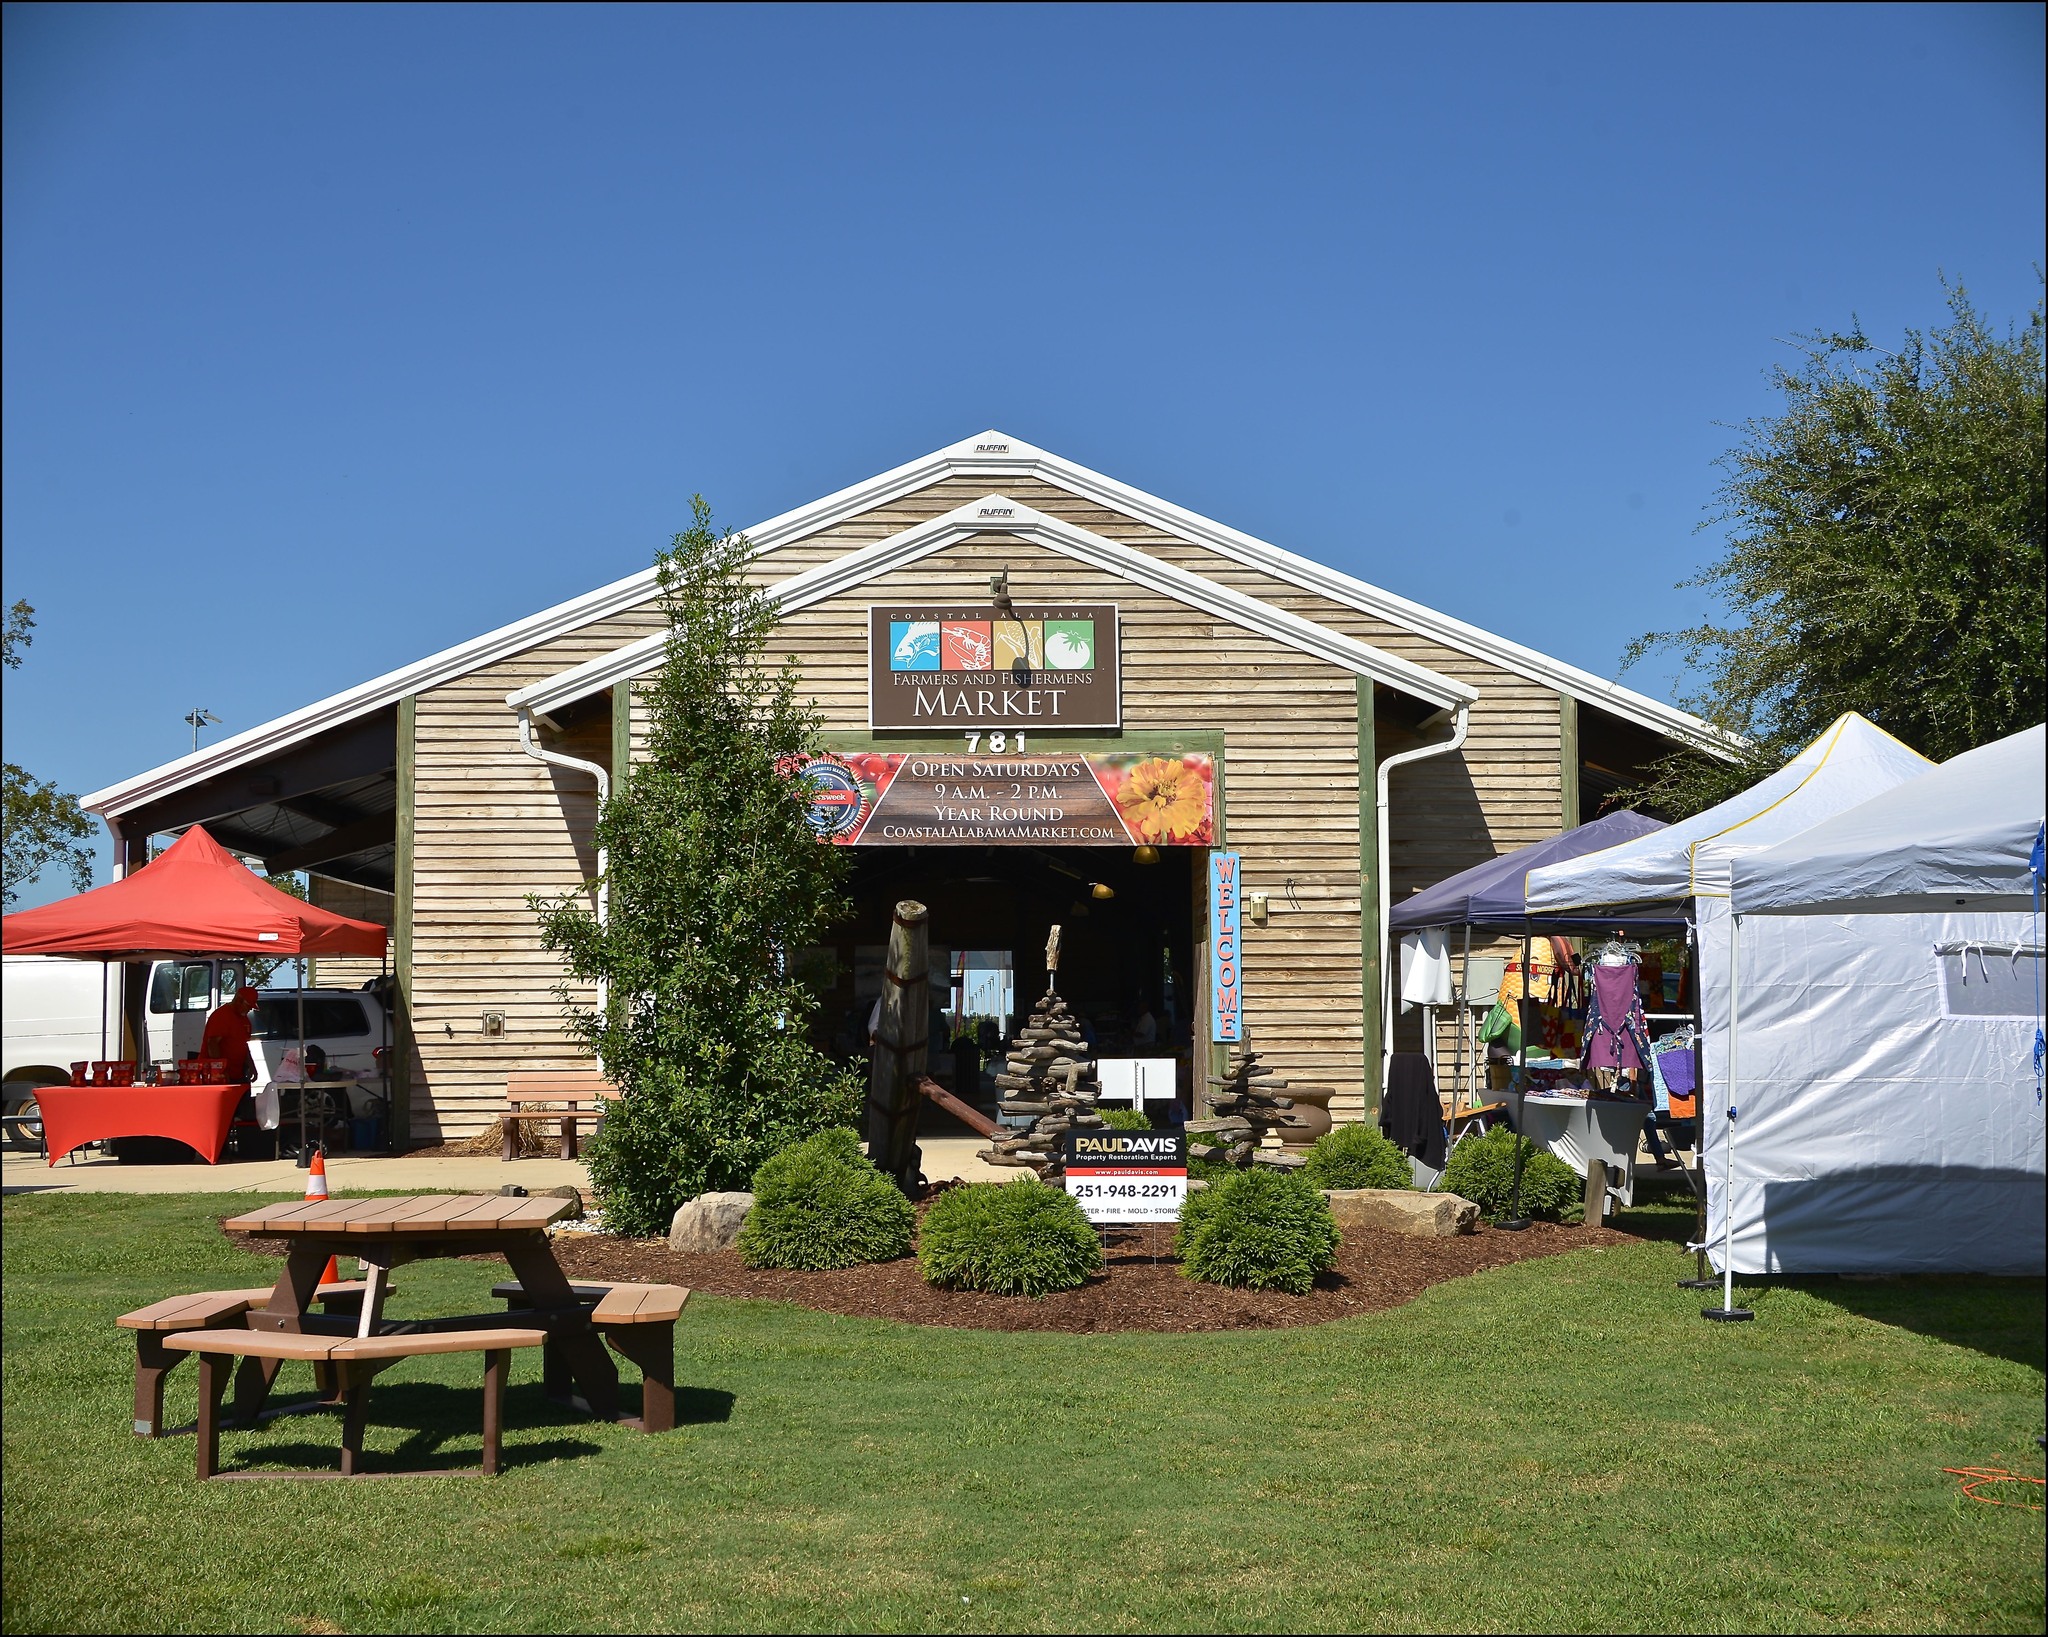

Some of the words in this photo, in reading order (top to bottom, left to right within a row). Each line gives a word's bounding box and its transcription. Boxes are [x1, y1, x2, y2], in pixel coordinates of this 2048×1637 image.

[890, 612, 982, 620] COASTAL
[893, 673, 958, 686] FARMERS
[963, 674, 996, 685] AND
[1001, 673, 1093, 685] FISHERMENS
[912, 687, 1066, 717] MARKET
[964, 731, 1026, 753] 781
[911, 761, 965, 777] OPEN
[972, 760, 1080, 777] SATURDAYS
[934, 784, 946, 799] 9
[952, 784, 990, 799] A.M.
[1009, 783, 1022, 799] 2
[1028, 784, 1063, 799] P.M.
[933, 805, 982, 822] YEAR
[987, 804, 1065, 822] ROUND
[1215, 857, 1238, 1039] WELCOME
[1076, 1153, 1107, 1162] Property
[1108, 1153, 1149, 1161] Restoration
[1150, 1153, 1177, 1162] Experts
[1075, 1184, 1177, 1198] 251-948-2291
